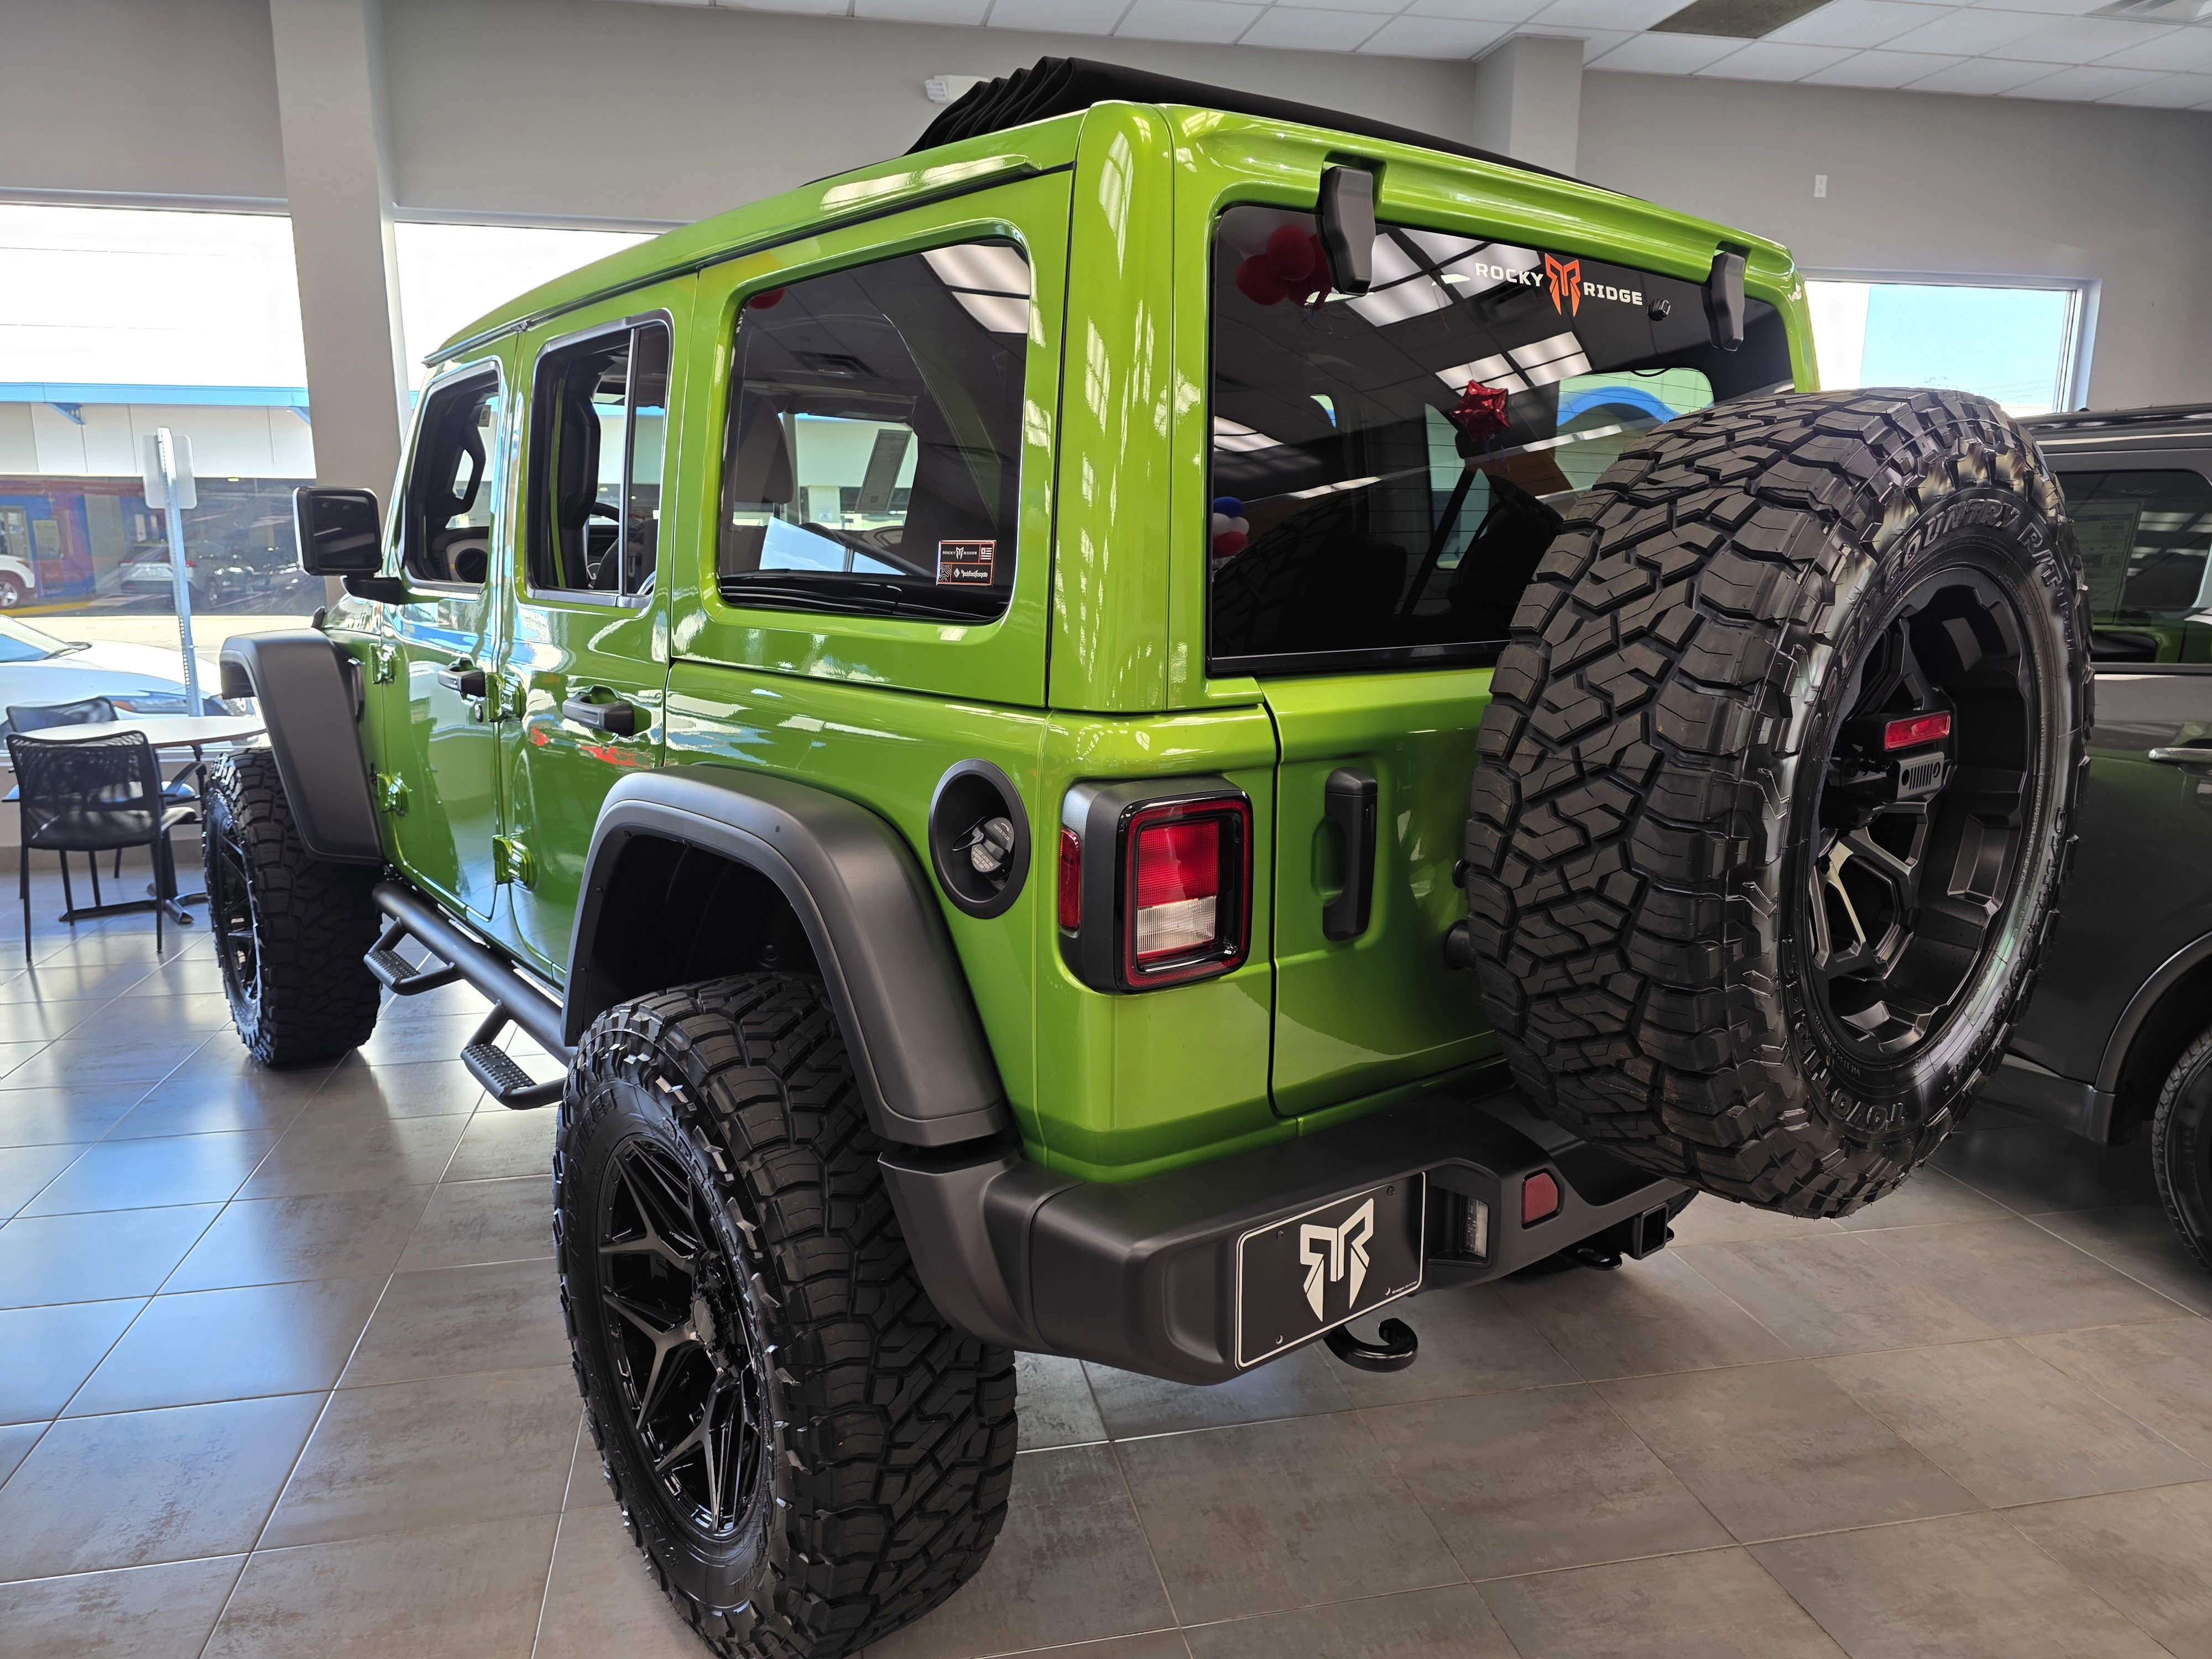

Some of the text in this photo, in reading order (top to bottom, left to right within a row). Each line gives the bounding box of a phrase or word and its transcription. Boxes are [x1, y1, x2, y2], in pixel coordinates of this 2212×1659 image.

[1475, 263, 1643, 305] ROCKY RIDGE
[1882, 498, 2021, 596] COUNTRY
[1829, 1083, 1906, 1134] TOYO
